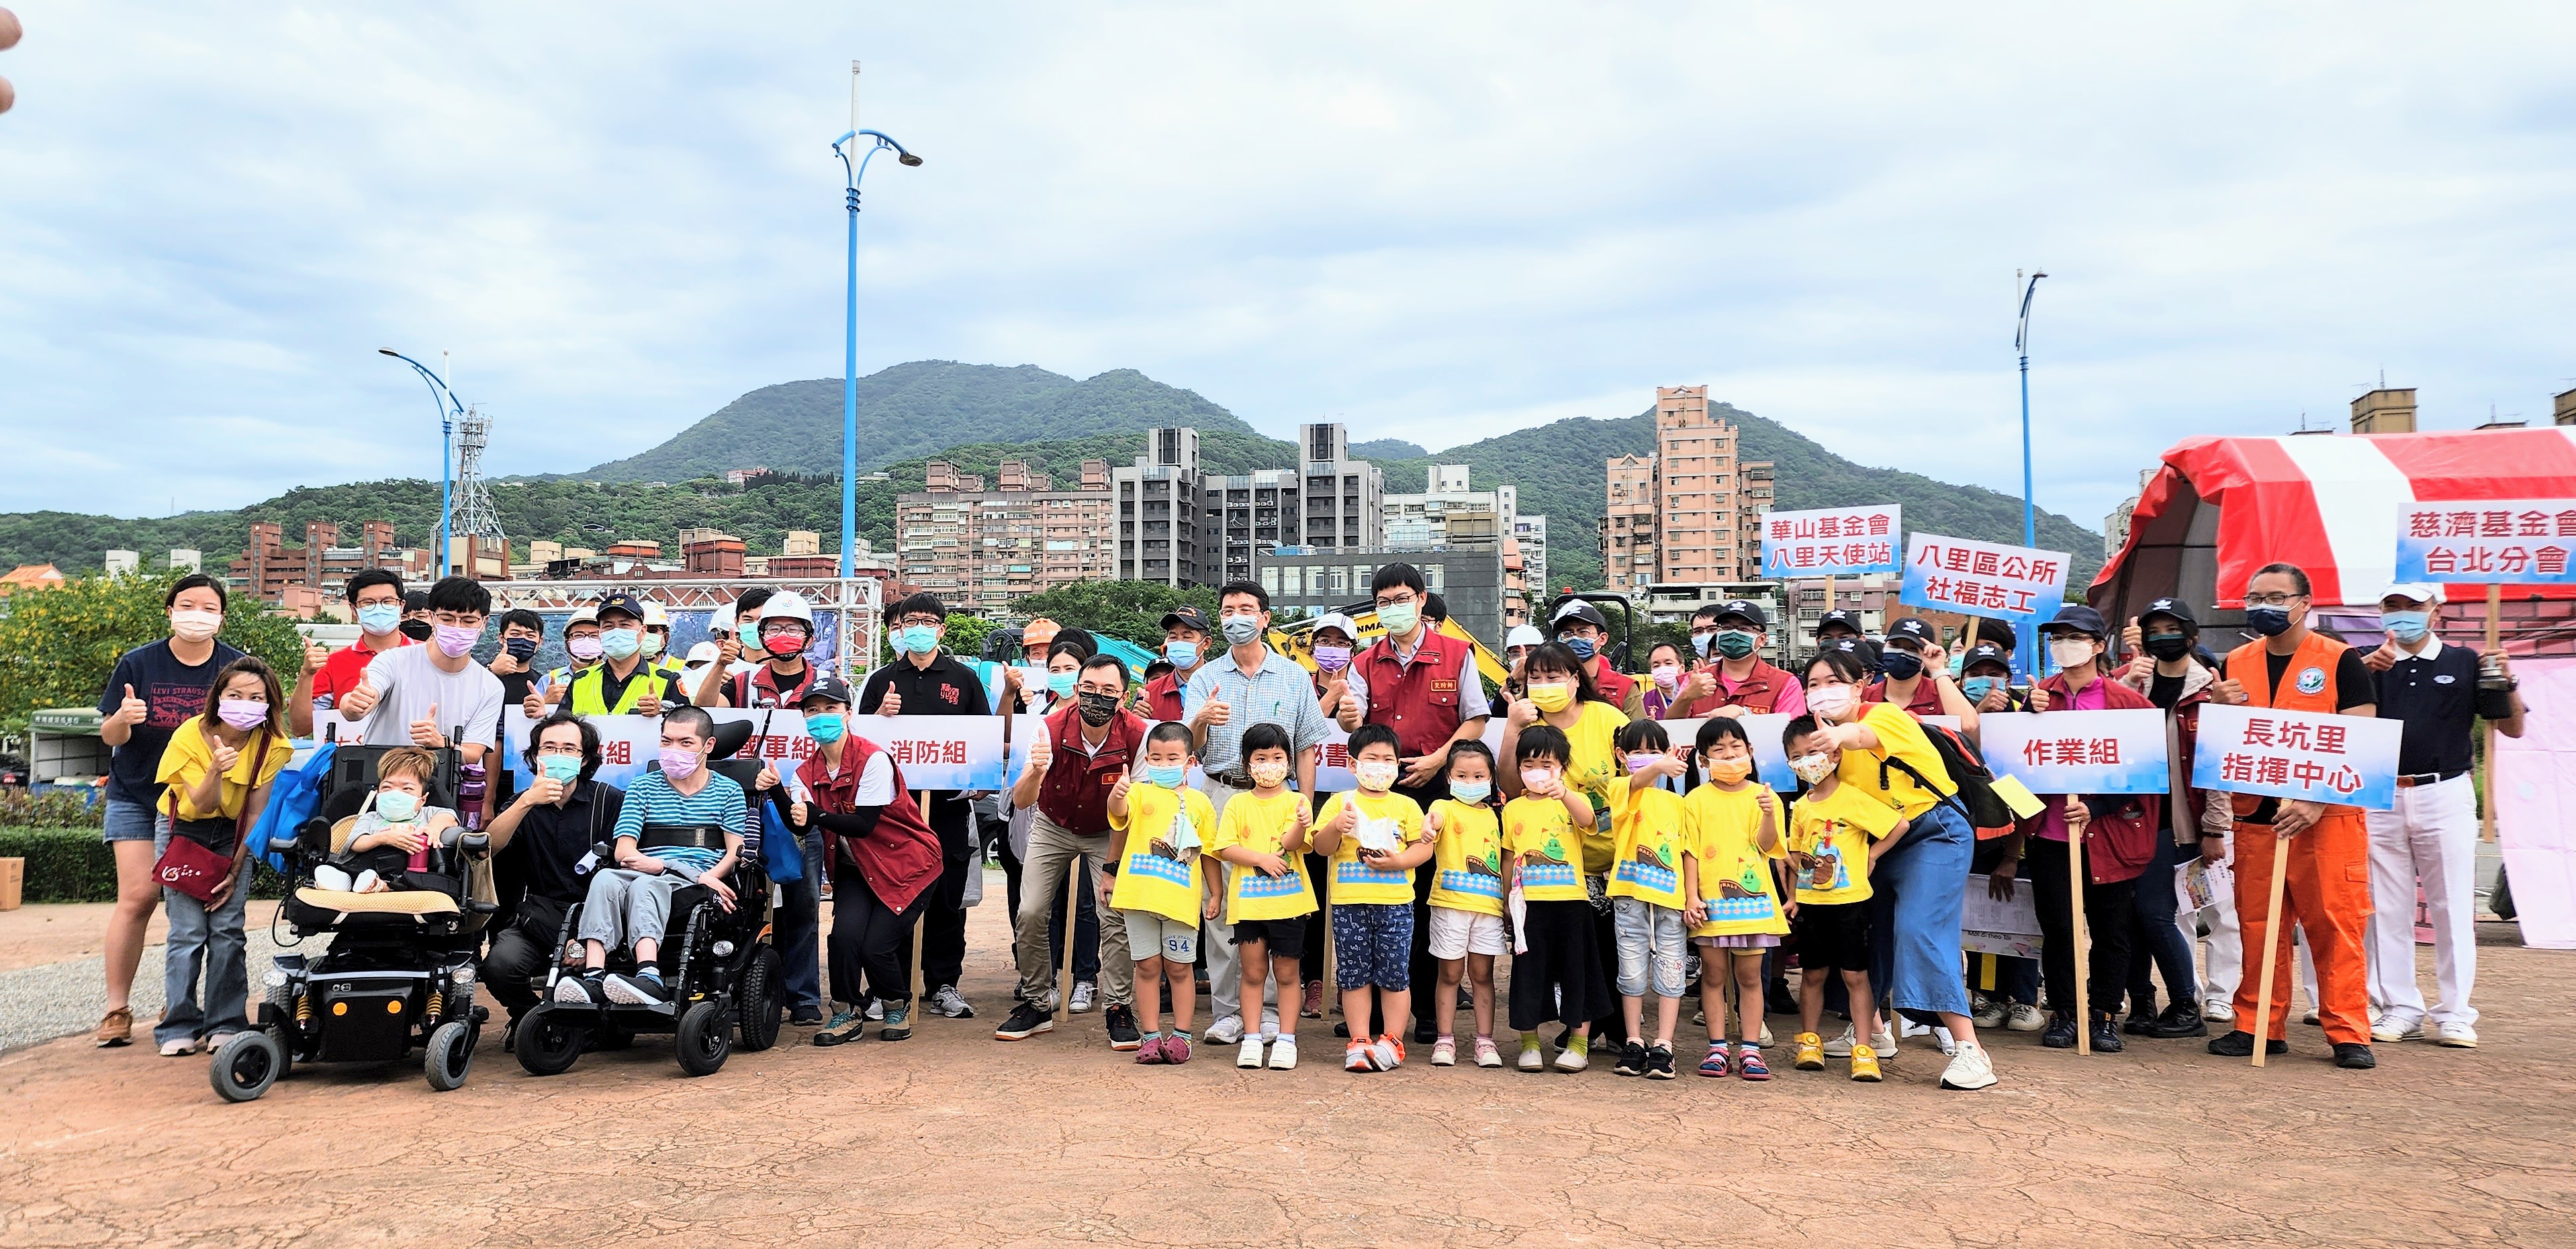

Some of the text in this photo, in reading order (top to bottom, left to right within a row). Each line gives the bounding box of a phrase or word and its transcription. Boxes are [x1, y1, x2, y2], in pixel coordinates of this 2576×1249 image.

[1770, 514, 1890, 541] 華山基金會
[2409, 510, 2576, 537] 慈濟基金會
[1771, 542, 1892, 568] 八里天使站
[1917, 545, 2058, 586] 八里區公所
[2426, 545, 2569, 573] 台北分會
[1926, 575, 2036, 613] 社福志工
[173, 688, 205, 696] STRAUSS
[2243, 718, 2346, 754] 長坑里
[890, 739, 966, 764] 消防組
[2023, 738, 2120, 766] 作業組
[2222, 752, 2362, 793] 指揮中心
[1169, 940, 1189, 952] 94
